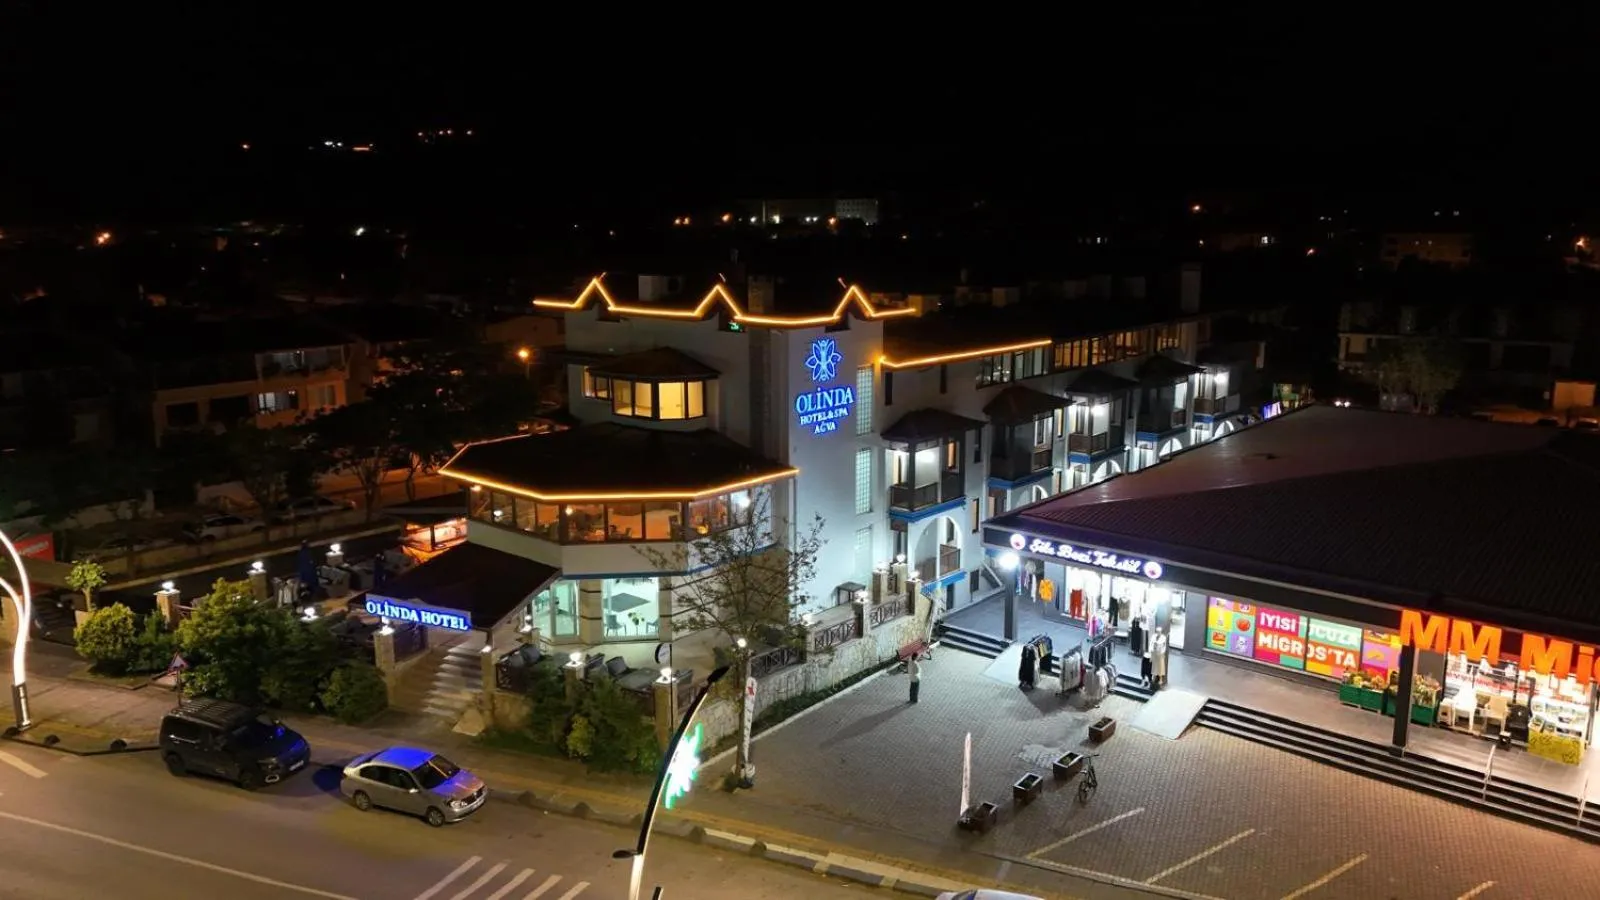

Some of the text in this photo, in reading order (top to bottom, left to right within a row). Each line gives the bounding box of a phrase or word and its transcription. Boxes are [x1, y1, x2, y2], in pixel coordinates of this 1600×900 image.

[796, 387, 854, 413] OLİNDA
[366, 601, 468, 630] OLİNDA HOTEL
[1400, 609, 1600, 686] MM Mi
